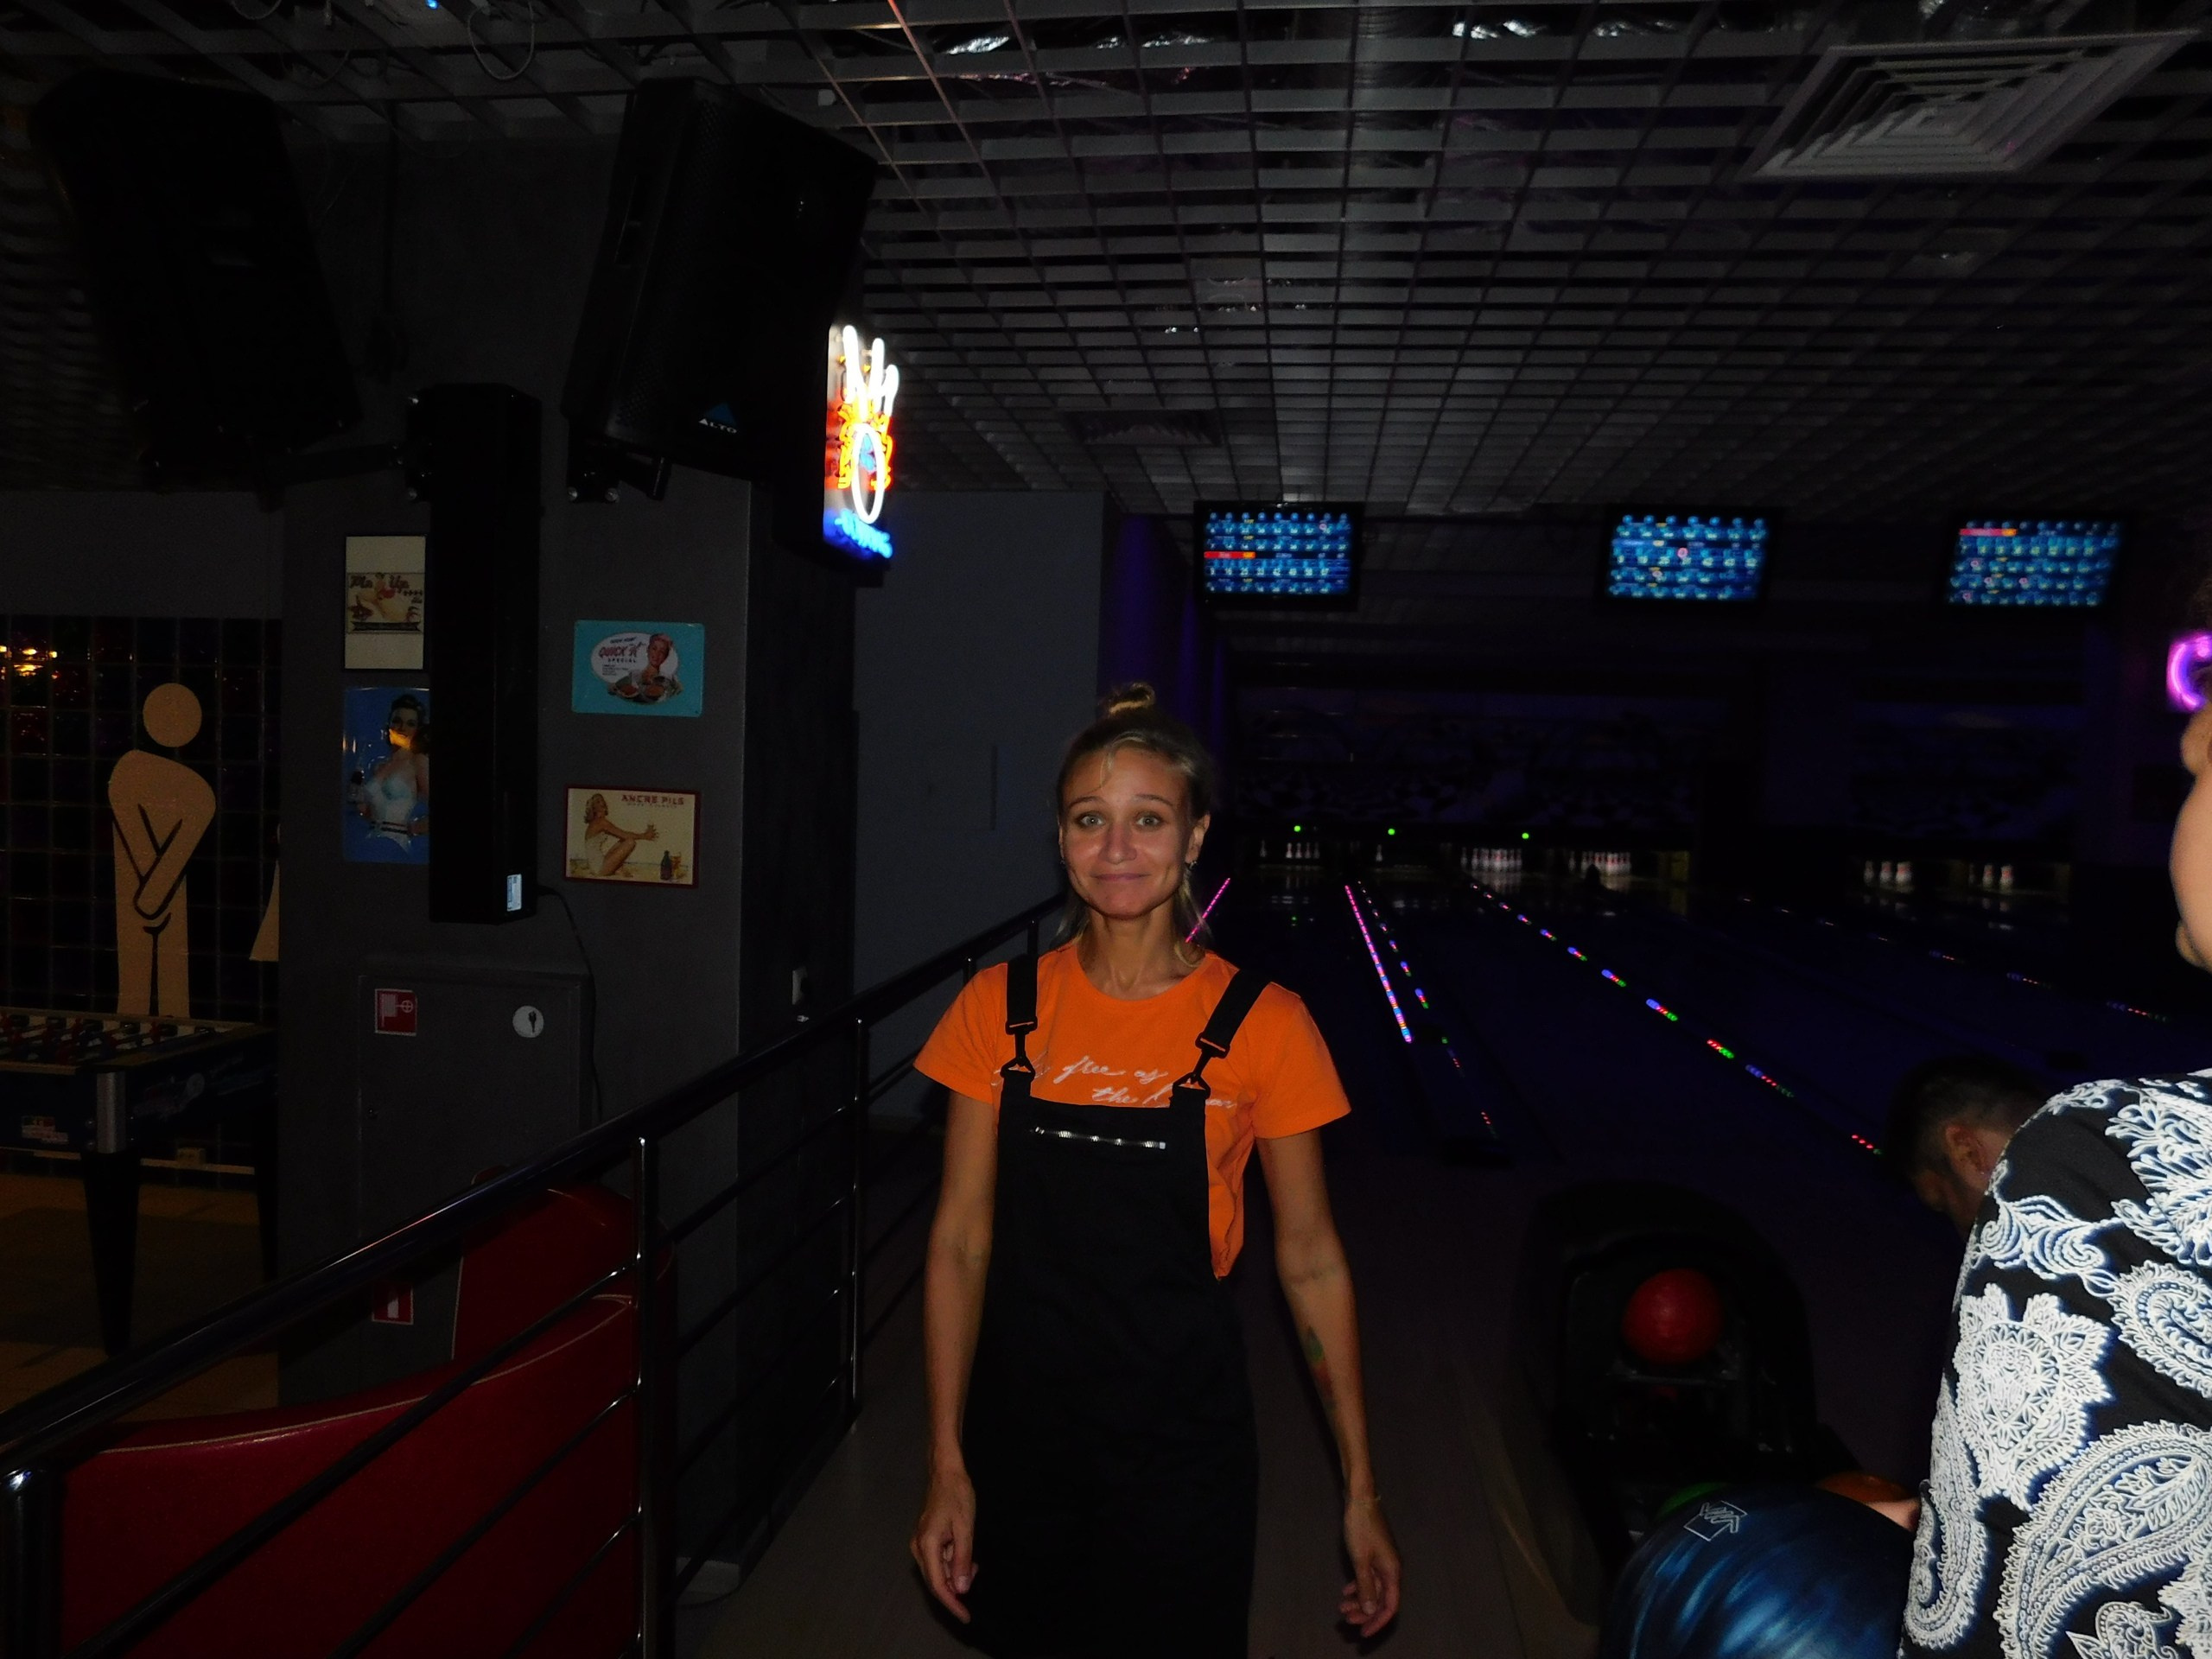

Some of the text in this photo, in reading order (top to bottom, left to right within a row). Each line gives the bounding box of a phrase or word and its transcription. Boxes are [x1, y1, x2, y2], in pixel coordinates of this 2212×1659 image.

[698, 418, 738, 434] ALTO
[1052, 1054, 1126, 1085] free
[1092, 1085, 1139, 1105] the
